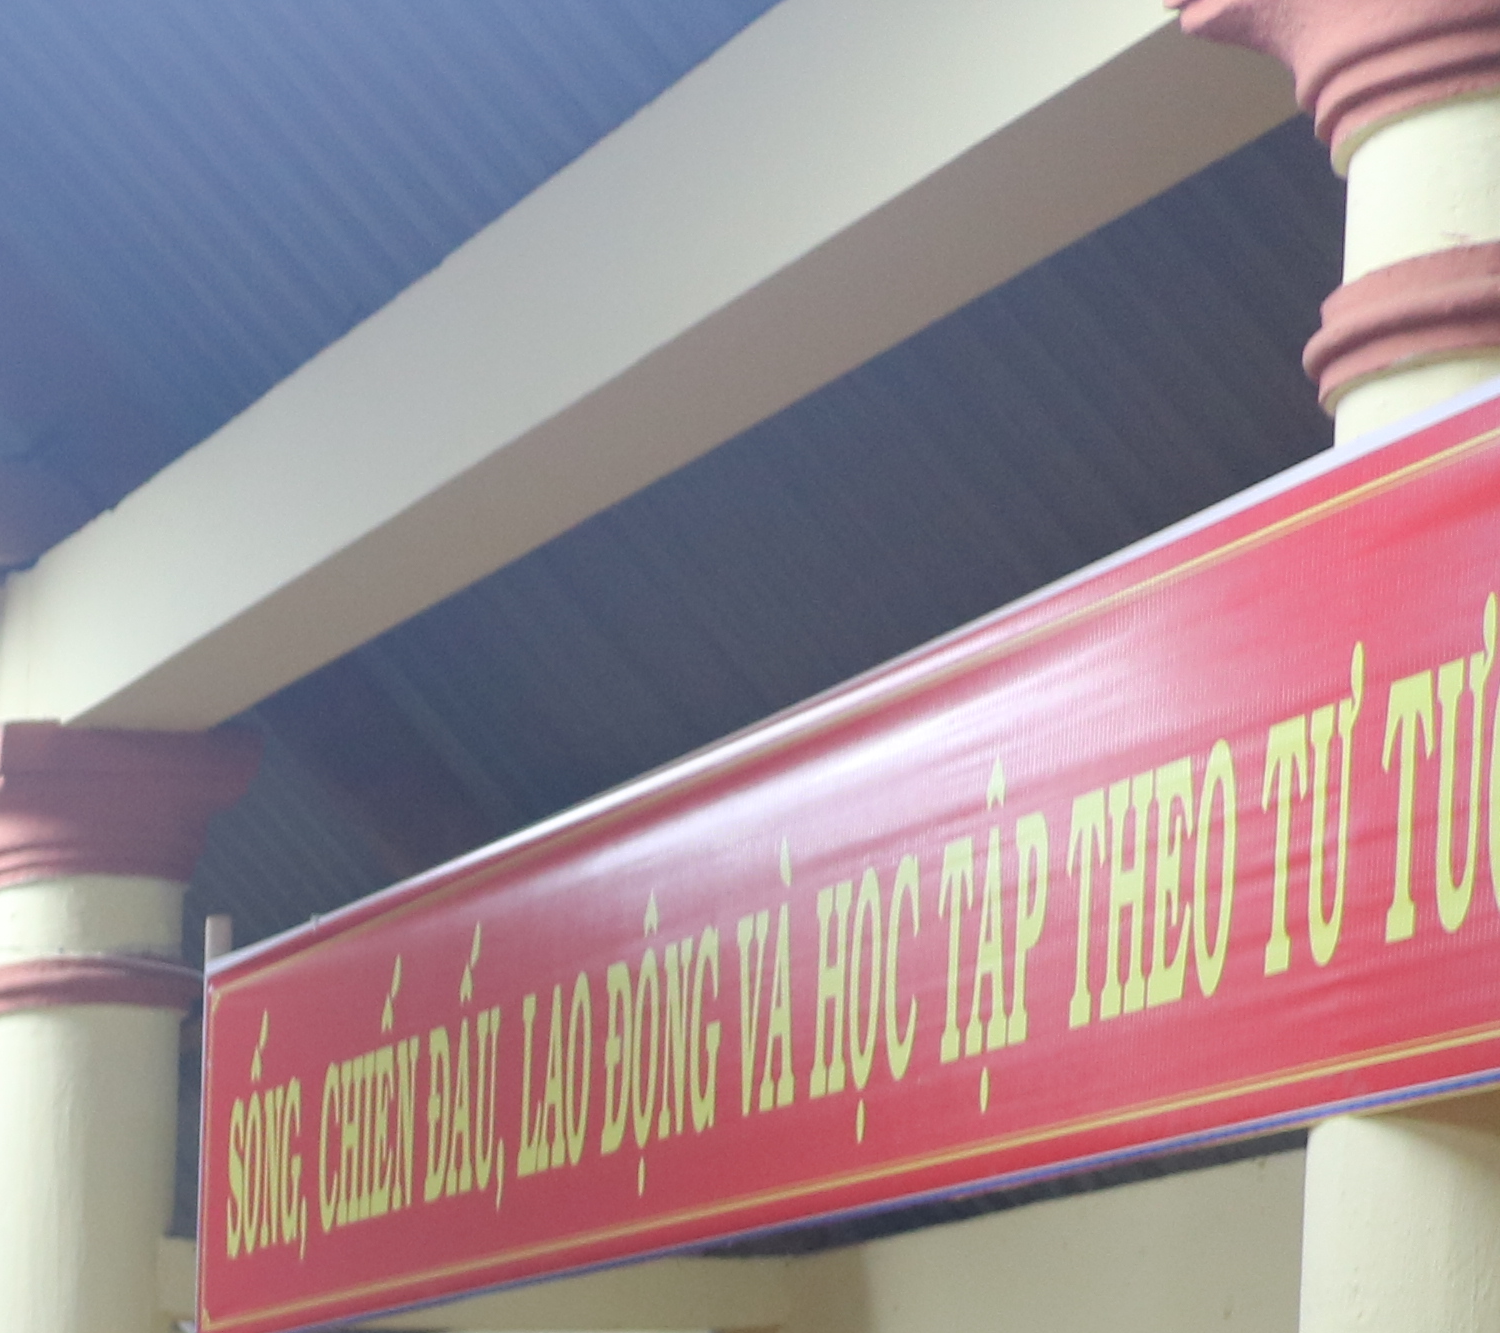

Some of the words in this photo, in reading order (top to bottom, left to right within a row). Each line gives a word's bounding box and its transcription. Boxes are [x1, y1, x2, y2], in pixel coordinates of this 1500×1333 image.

[226, 1009, 307, 1260] SỐNG,
[318, 954, 419, 1234] CHIẾN
[423, 920, 506, 1210] ĐẤU,
[516, 971, 592, 1178] LAO
[600, 888, 721, 1197] ĐỘNG
[736, 835, 795, 1117] VÀ
[809, 854, 921, 1145] HỌC
[938, 755, 1049, 1115] TẬP
[1066, 737, 1238, 1032] THEO
[1262, 641, 1365, 976] TƯ
[1380, 591, 1500, 944] TƯ
